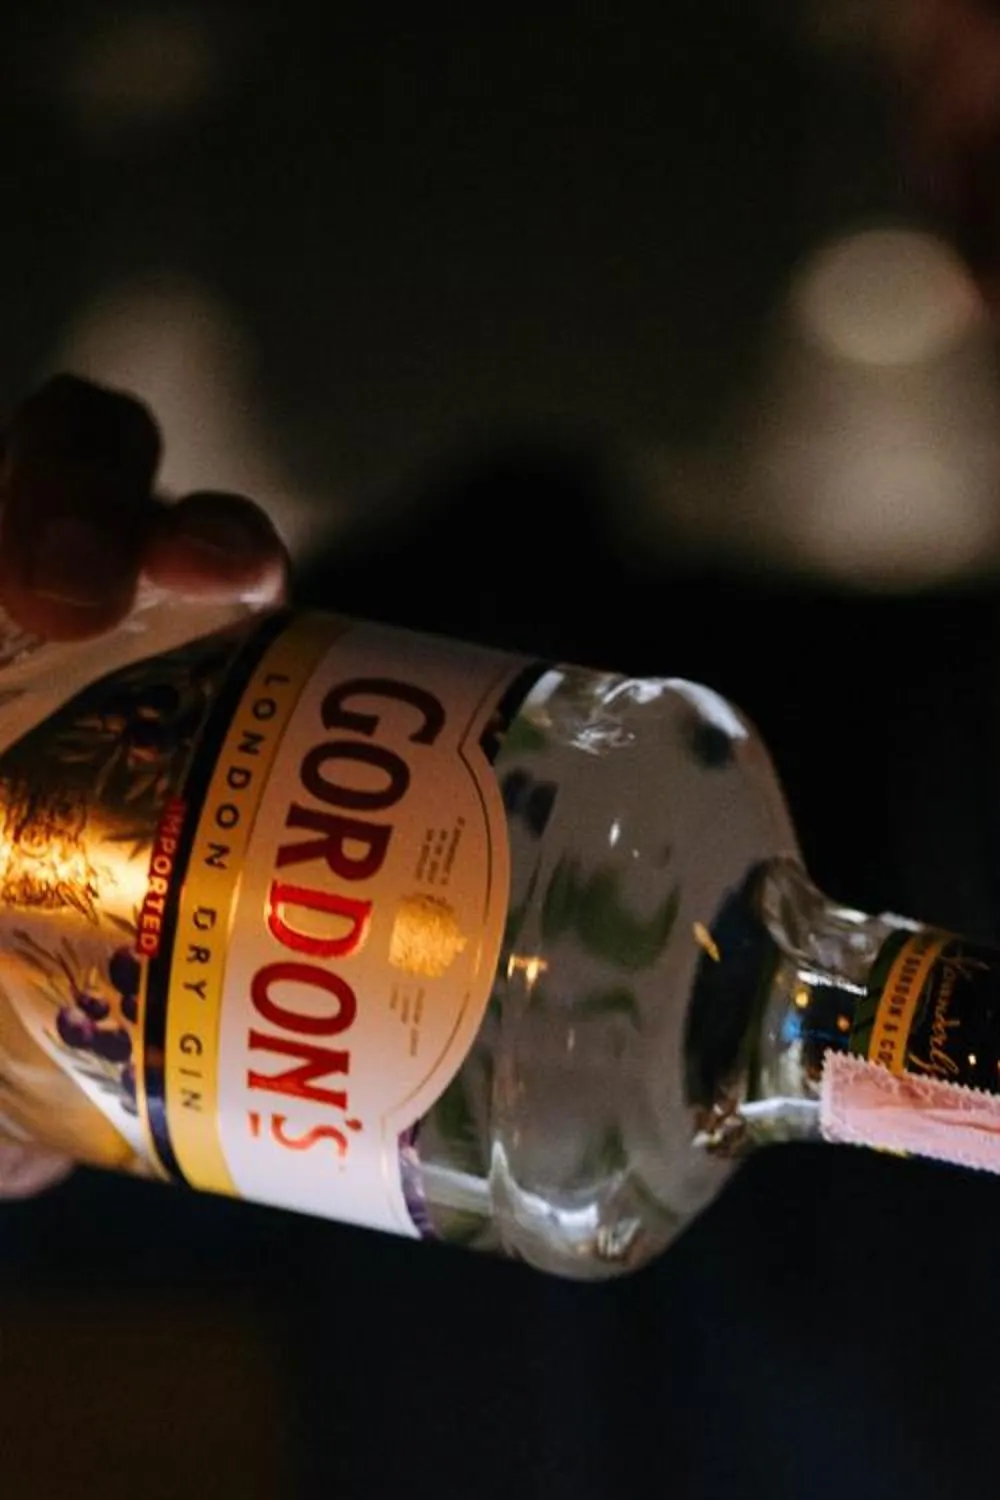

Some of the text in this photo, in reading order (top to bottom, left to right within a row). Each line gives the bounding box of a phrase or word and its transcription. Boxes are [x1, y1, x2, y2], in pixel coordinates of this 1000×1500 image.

[138, 803, 185, 951] IMPORTED
[178, 673, 290, 1114] LONDON DRY GIN
